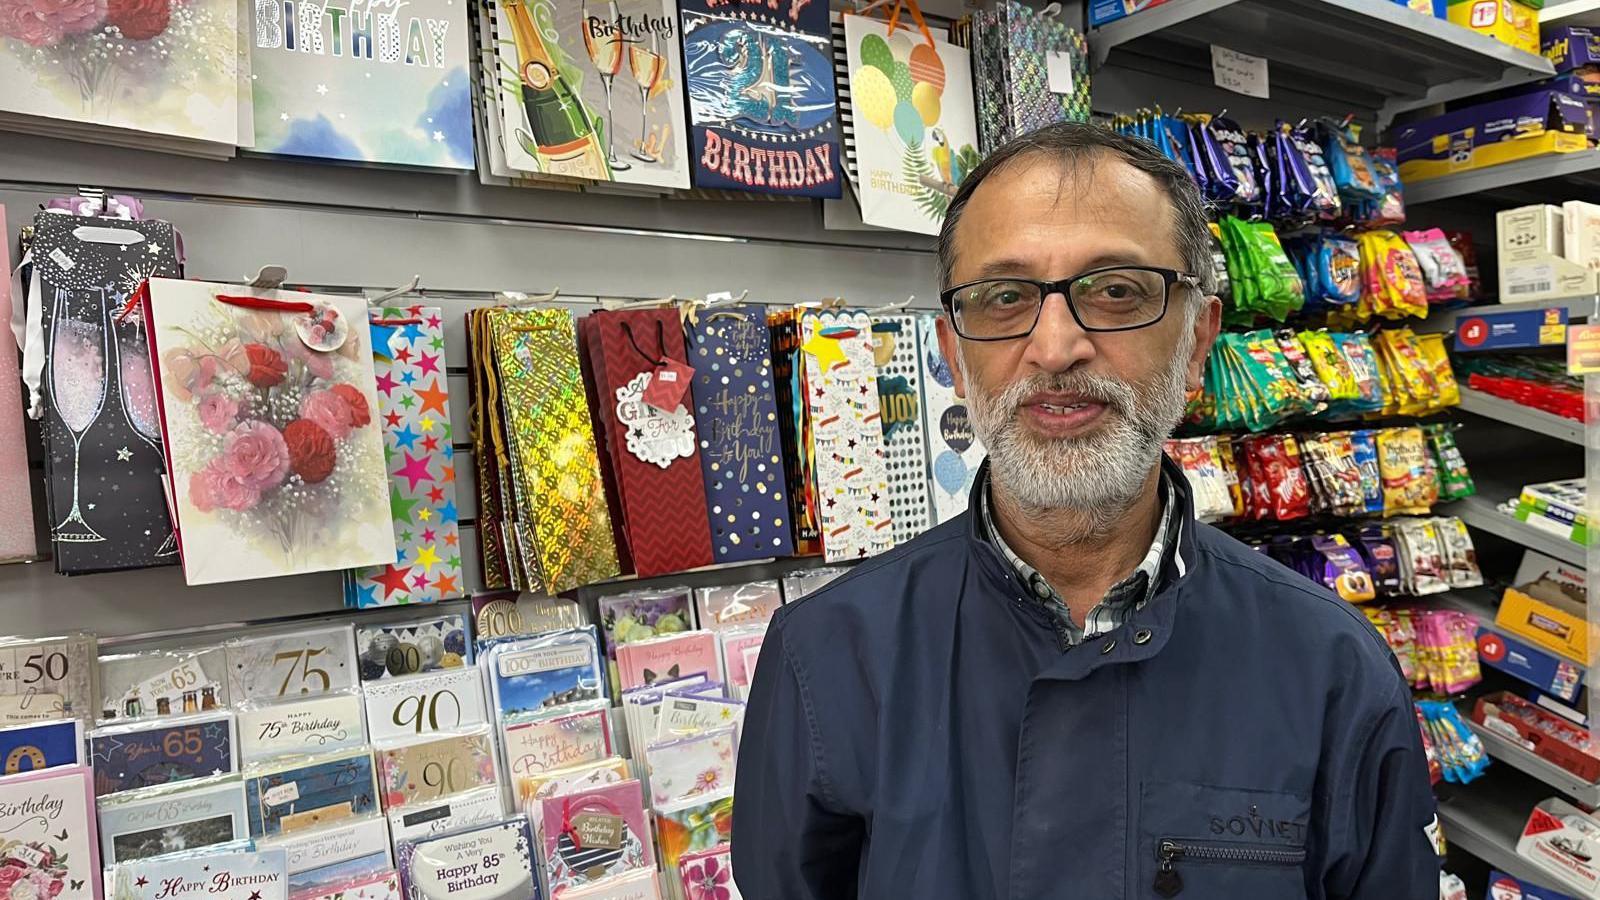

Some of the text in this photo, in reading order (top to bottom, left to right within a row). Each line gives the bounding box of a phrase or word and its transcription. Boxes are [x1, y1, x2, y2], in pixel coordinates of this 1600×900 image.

[255, 0, 450, 68] BIRTHDAY
[588, 13, 676, 41] Birthday
[701, 129, 834, 190] BIRTHDAY
[708, 389, 763, 418] Happy
[1547, 504, 1574, 521] POLO
[484, 608, 521, 637] 100
[23, 652, 69, 683] 50
[272, 646, 331, 697] 75
[390, 646, 420, 672] 90
[171, 664, 197, 690] 65
[287, 711, 312, 719] HAPPY
[393, 689, 460, 734] 90
[291, 717, 341, 735] Birthday
[163, 727, 203, 757] 65
[521, 732, 556, 750] Happy
[512, 736, 604, 774] Birthday
[582, 822, 615, 836] Birthday
[582, 834, 611, 844] Wishes
[444, 836, 493, 853] Wishing You
[456, 847, 483, 860] A Very
[155, 871, 280, 899] HAPPY BIRTHDAY
[436, 863, 478, 881] Happy
[447, 873, 499, 893] Birthday
